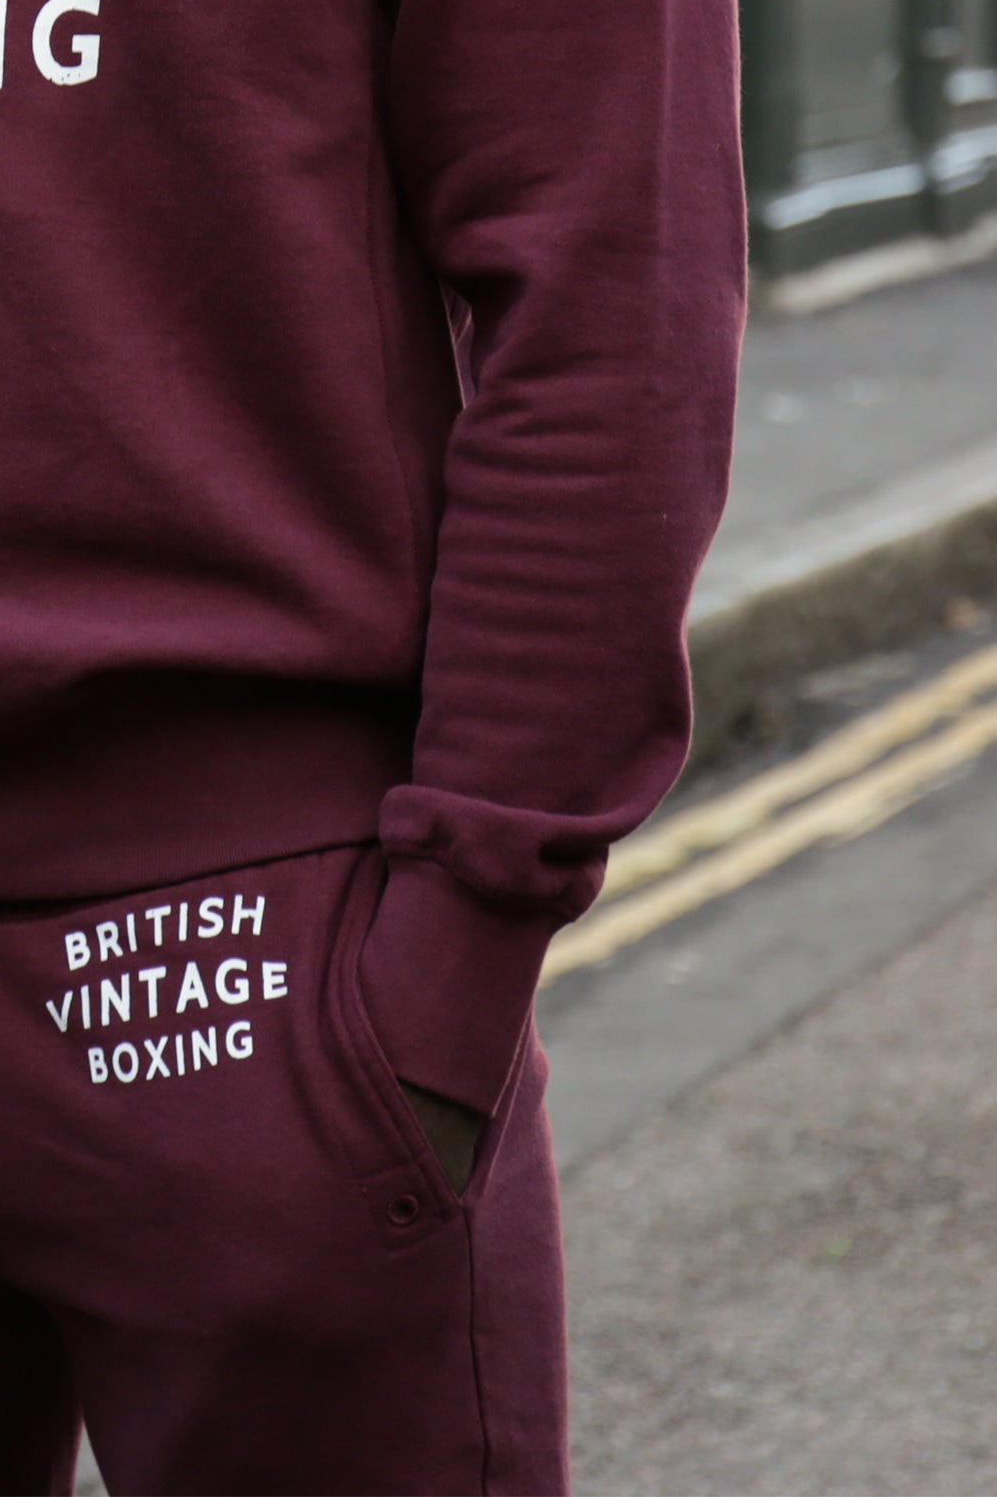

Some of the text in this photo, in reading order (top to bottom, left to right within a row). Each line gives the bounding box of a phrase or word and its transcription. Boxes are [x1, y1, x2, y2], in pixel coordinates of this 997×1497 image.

[64, 894, 266, 971] BRITISH
[45, 957, 288, 1033] VINTAGE
[87, 1020, 254, 1084] BOXING
